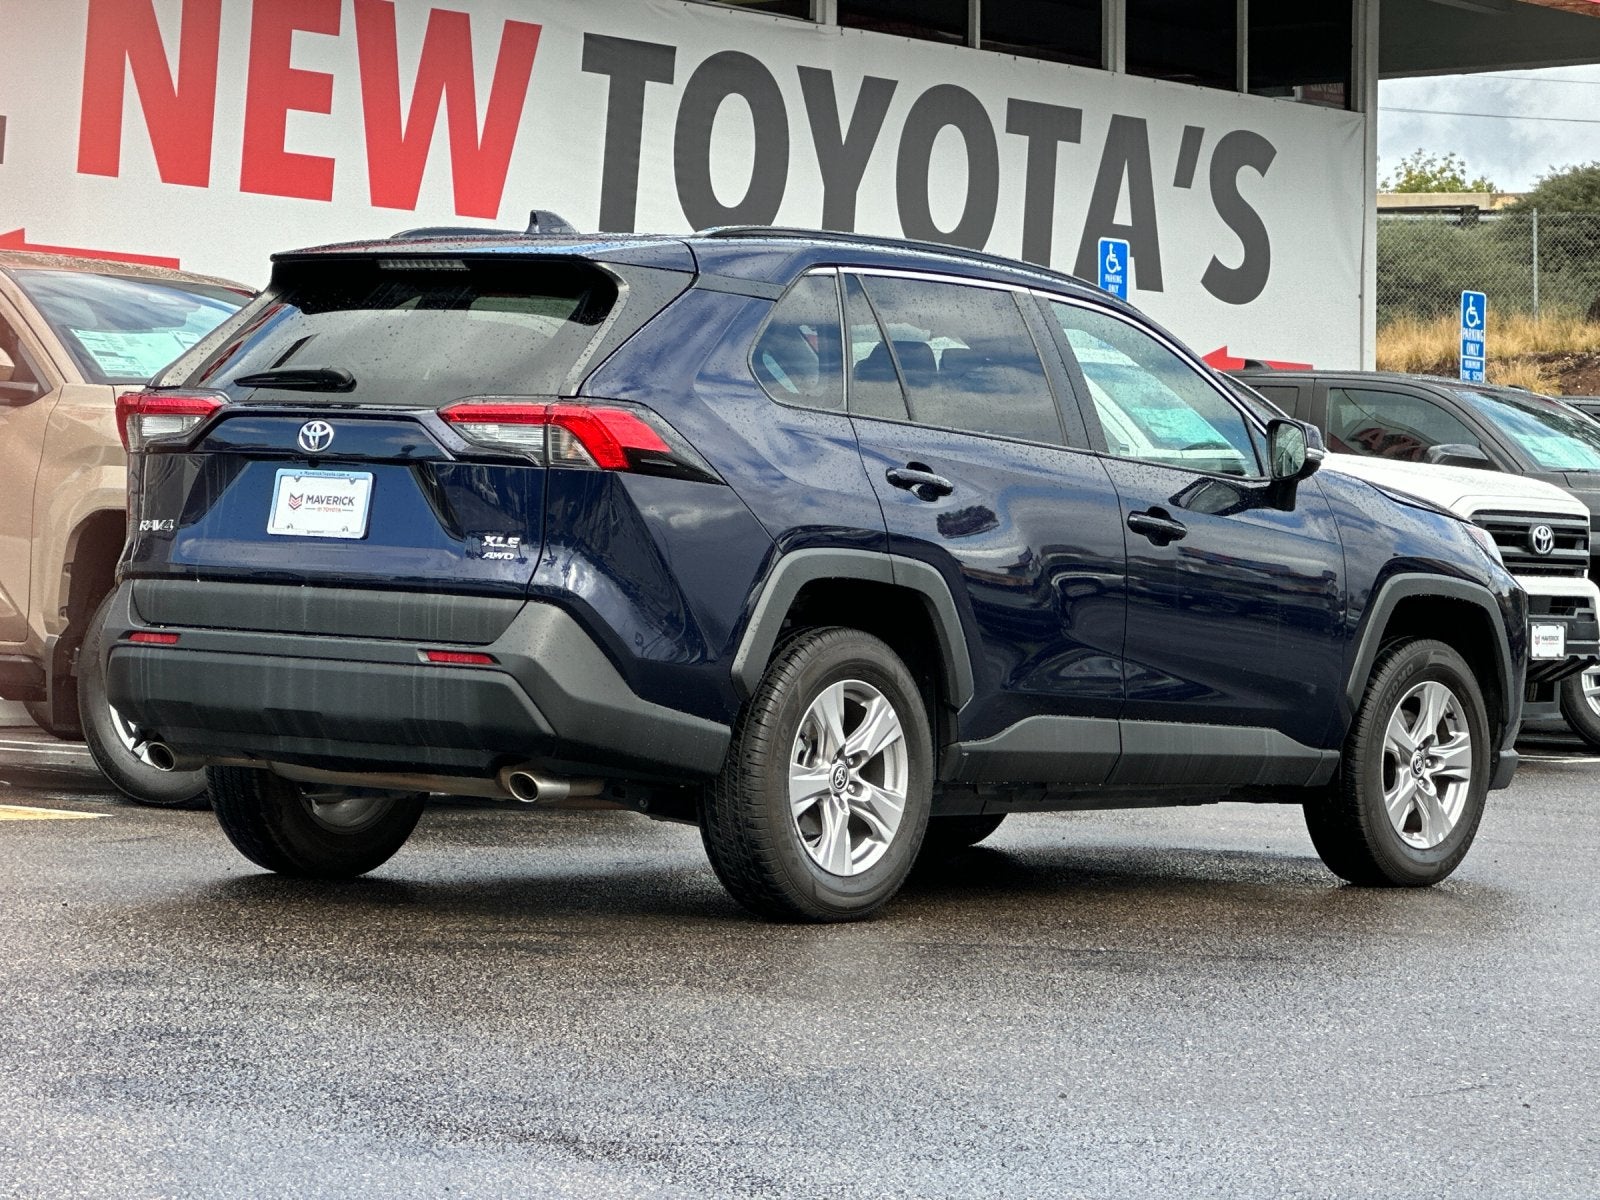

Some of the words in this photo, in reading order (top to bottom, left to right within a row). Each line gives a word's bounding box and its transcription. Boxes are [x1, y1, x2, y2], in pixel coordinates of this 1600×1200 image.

[77, 0, 542, 220] NEW
[581, 32, 1277, 305] TOYOTA'S
[1104, 273, 1123, 284] PARKING
[1462, 327, 1484, 342] PARKING
[1466, 341, 1480, 356] ONLY
[305, 494, 356, 507] MAVERICK
[139, 519, 174, 531] RAV4
[482, 535, 520, 548] XLE
[482, 551, 515, 560] AWD
